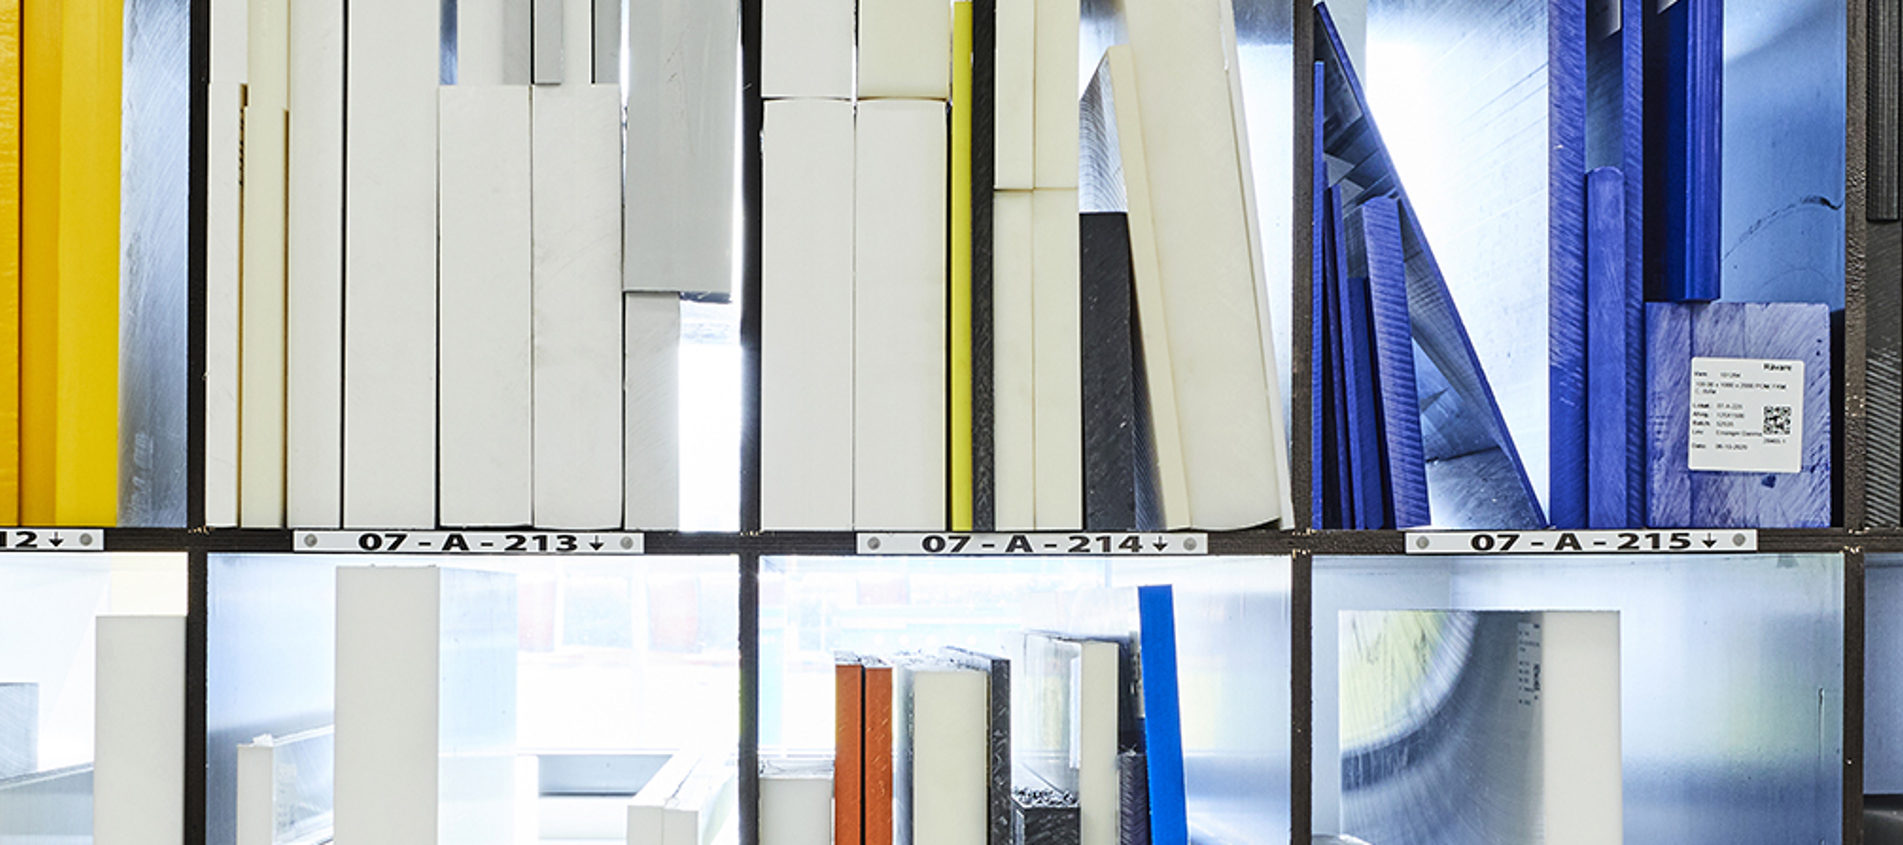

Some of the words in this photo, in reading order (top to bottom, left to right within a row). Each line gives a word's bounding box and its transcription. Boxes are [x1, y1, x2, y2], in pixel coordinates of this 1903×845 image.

[358, 533, 408, 551] 07
[441, 533, 470, 551] A
[504, 534, 578, 552] 213
[922, 535, 971, 552] 07
[1005, 534, 1033, 552] A
[1068, 535, 1143, 552] 214
[1470, 534, 1521, 551] 07
[1554, 533, 1583, 551] A
[1617, 533, 1692, 550] 215
